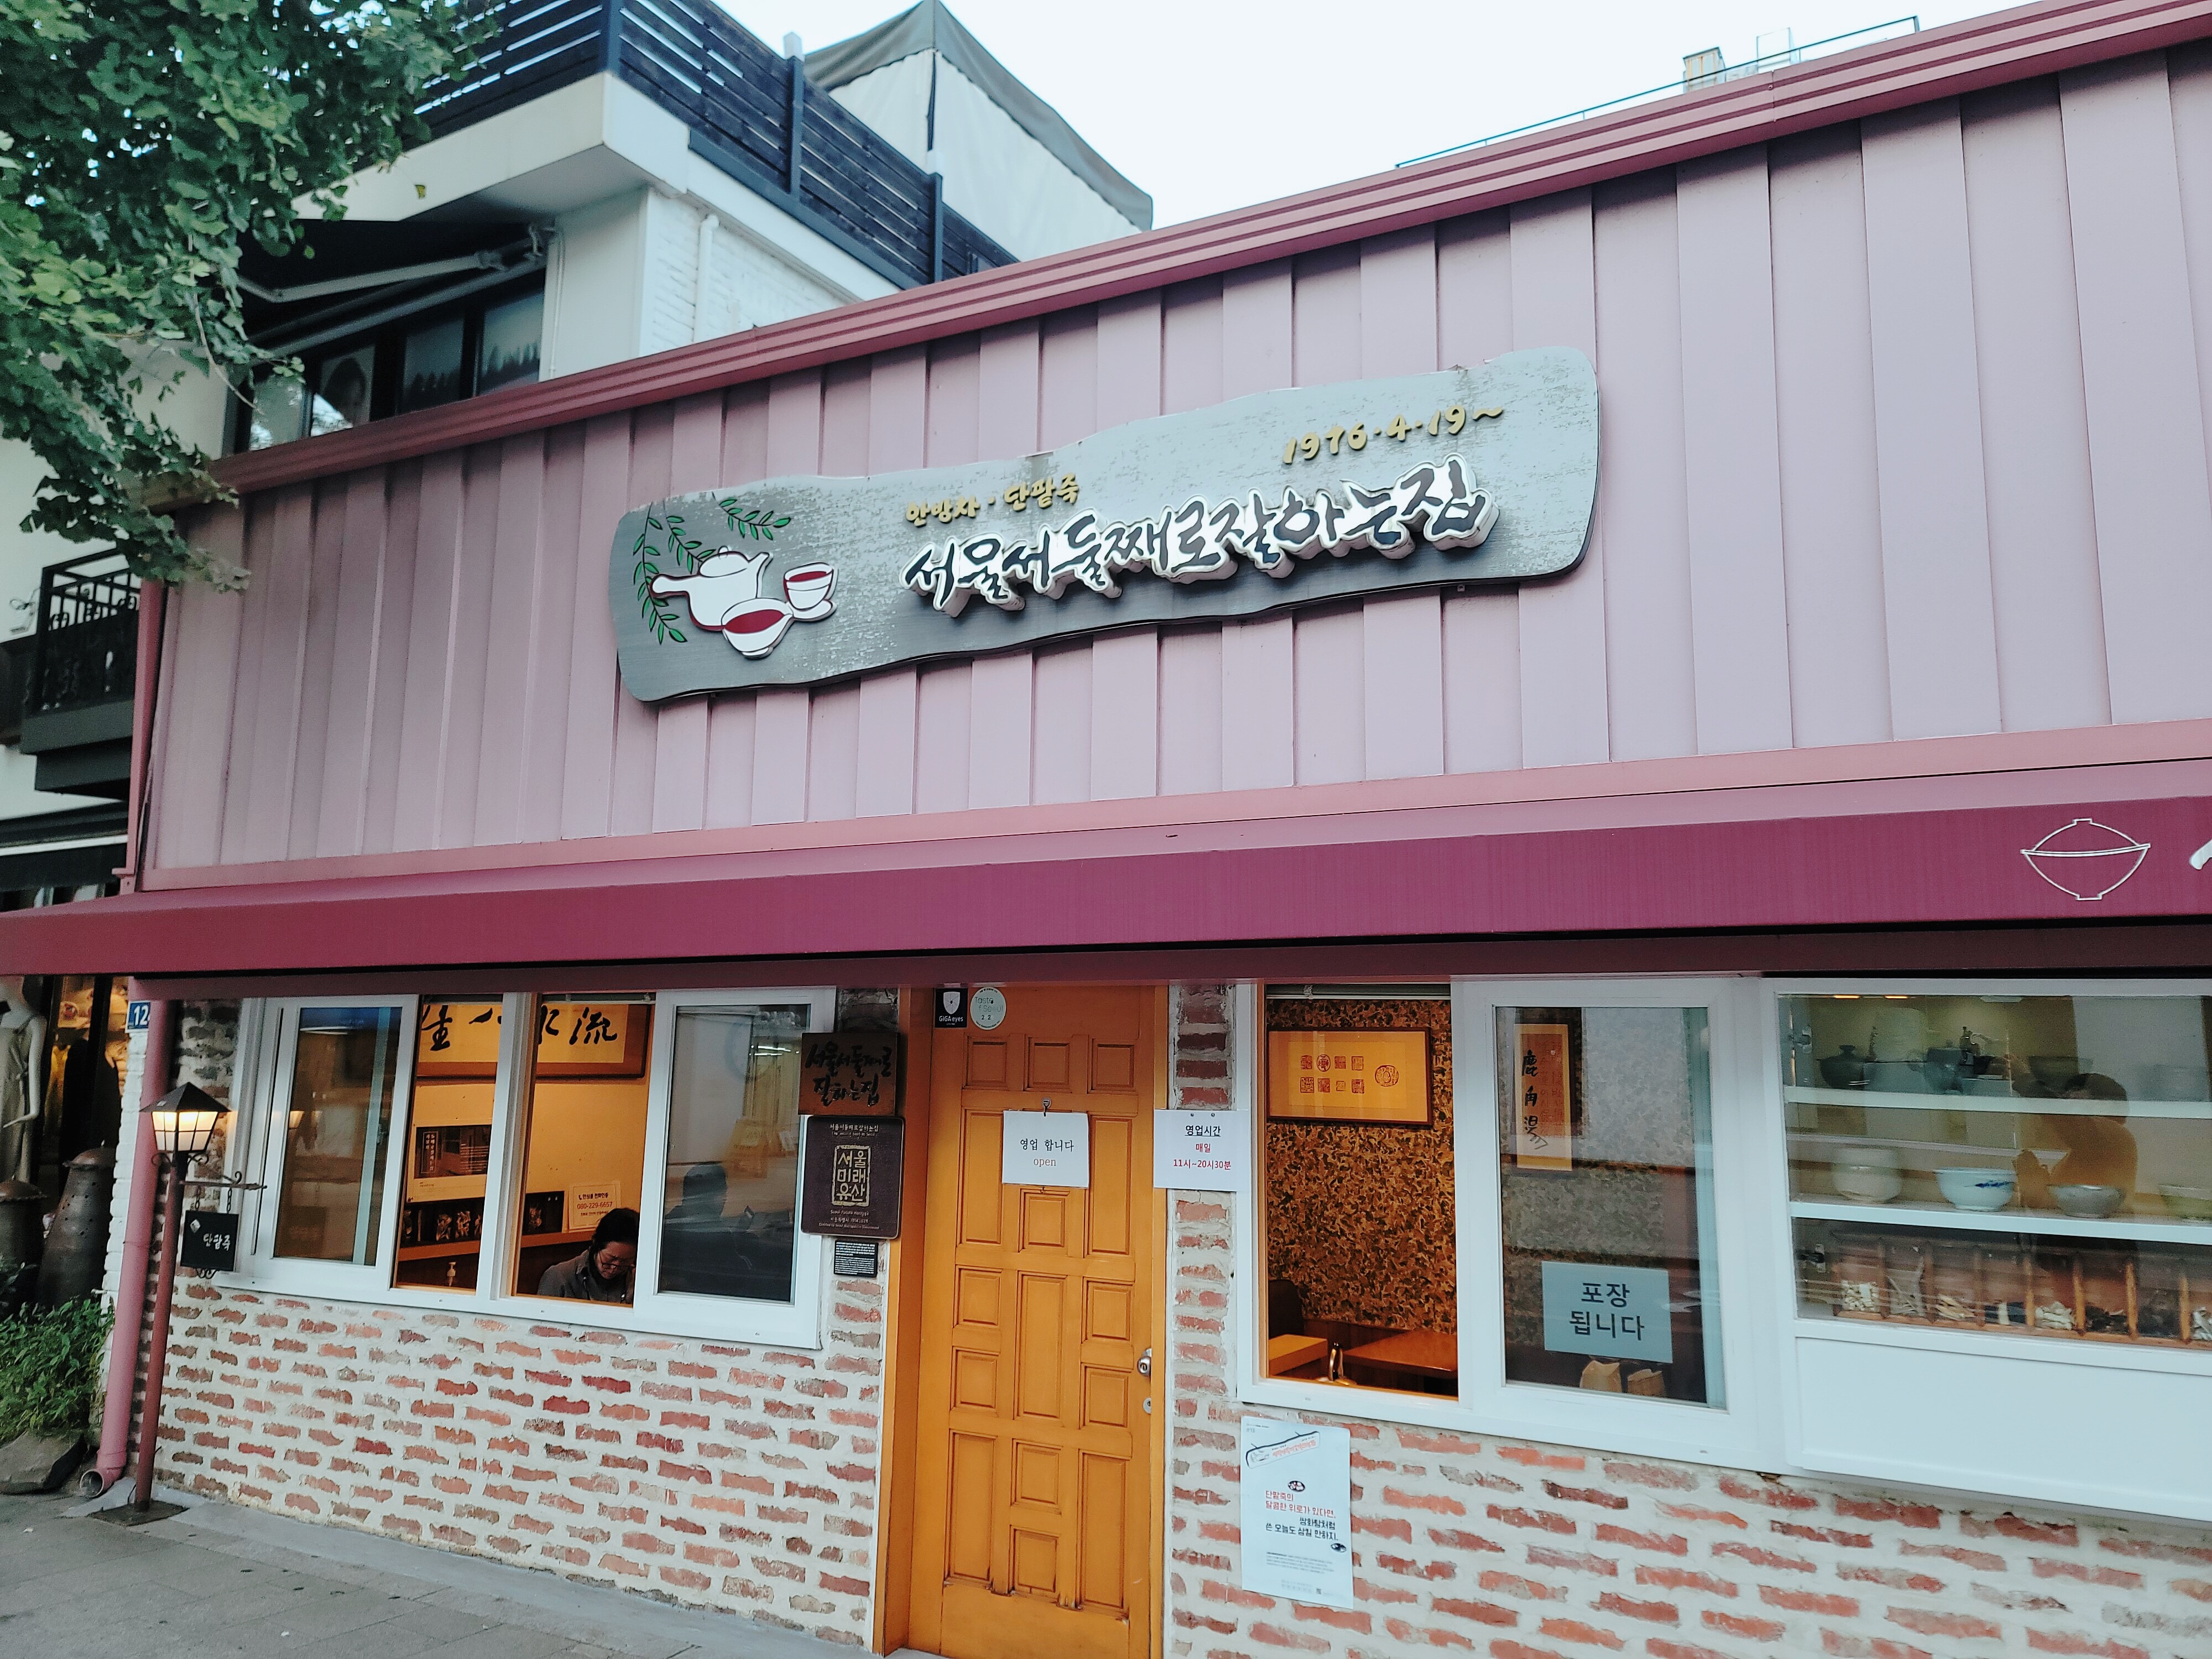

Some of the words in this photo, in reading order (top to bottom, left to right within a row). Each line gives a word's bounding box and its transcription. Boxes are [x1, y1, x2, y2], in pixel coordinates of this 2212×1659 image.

[1186, 1125, 1221, 1137] 영업시간
[1020, 1138, 1038, 1151] 영업
[1045, 1139, 1074, 1152] 합니다
[1196, 1143, 1211, 1153] 매일
[838, 1150, 867, 1168] 서울
[1034, 1159, 1057, 1167] open
[1173, 1159, 1232, 1170] 11시~20시30분
[837, 1168, 866, 1183] 미래
[836, 1183, 865, 1201] 유산
[1581, 1282, 1630, 1308] 포장
[1569, 1311, 1645, 1341] 됩니다
[1266, 1501, 1286, 1511] 달콤한
[1289, 1504, 1310, 1515] 위로가
[1275, 1524, 1296, 1535] 오늘도
